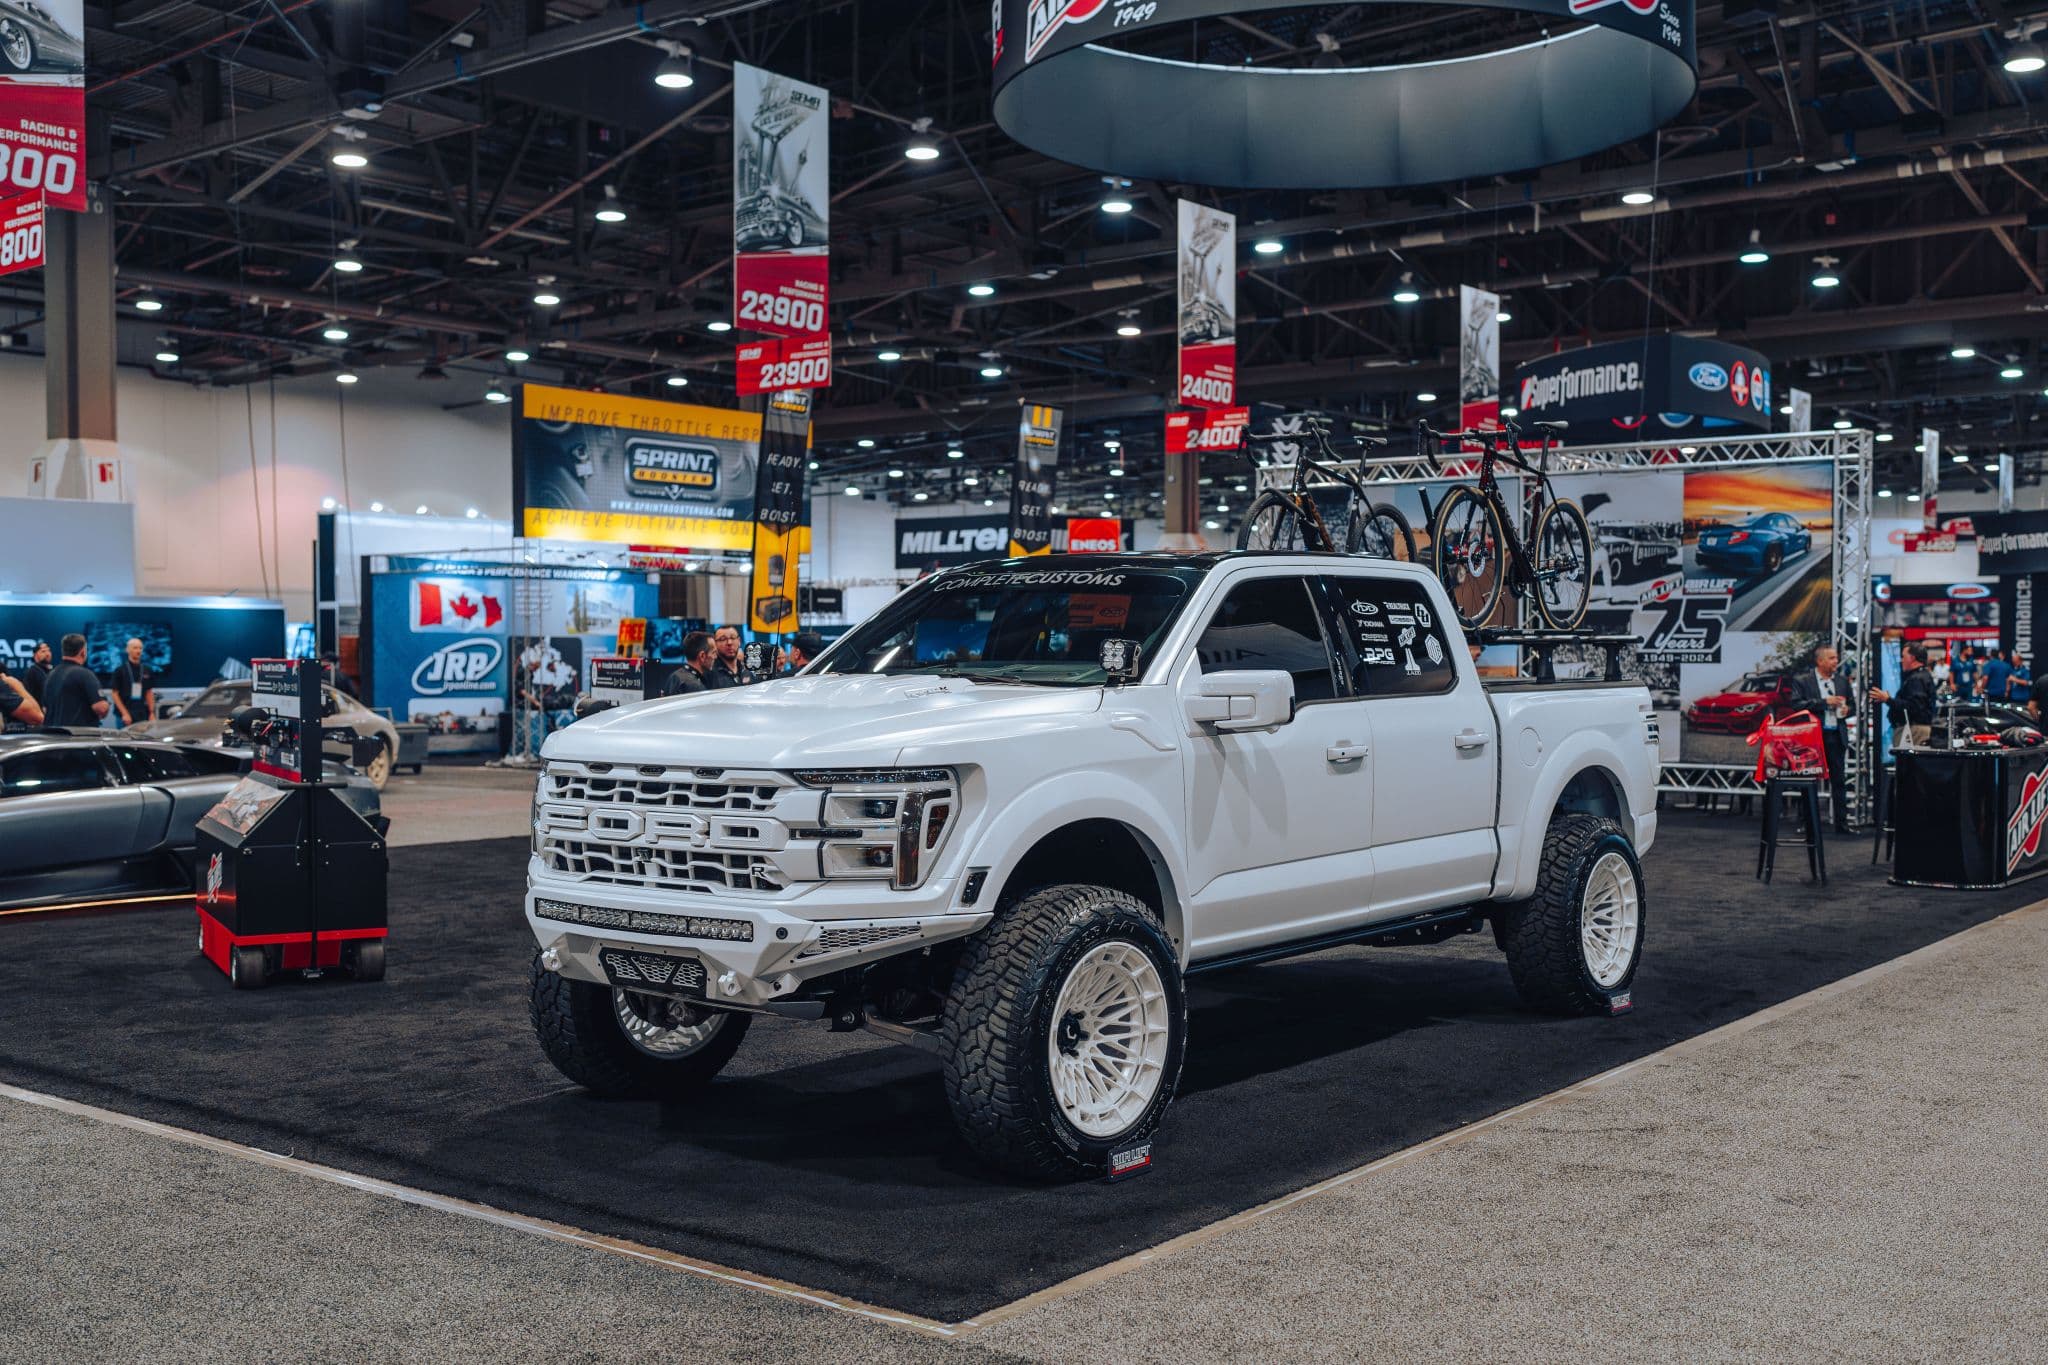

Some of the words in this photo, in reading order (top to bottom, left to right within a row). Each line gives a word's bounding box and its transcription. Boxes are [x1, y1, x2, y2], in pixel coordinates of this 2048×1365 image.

[1114, 2, 1157, 27] 1949
[0, 128, 78, 153] ERFORMANCE
[20, 119, 66, 138] RACING
[68, 129, 78, 140] &
[0, 224, 42, 266] 800
[740, 290, 824, 332] 23900
[759, 357, 829, 388] 23900
[1182, 374, 1232, 404] 24000
[541, 403, 620, 427] IMPROVE
[631, 413, 712, 439] THROTTLE
[722, 423, 760, 442] RESP
[633, 447, 714, 473] SPRINT
[532, 508, 612, 529] ACHIEVE
[624, 515, 708, 535] ULTIMATE
[719, 520, 750, 537] CON
[1070, 539, 1117, 551] ENEOS
[619, 623, 645, 642] FREE
[1642, 598, 1728, 650] 75
[1643, 654, 1713, 662] 1949-2024
[1654, 634, 1706, 653] Years
[427, 651, 489, 681] JRP
[539, 804, 790, 850] FORD
[2010, 811, 2029, 857] AIR
[2031, 778, 2048, 825] LIF
[751, 866, 765, 877] R
